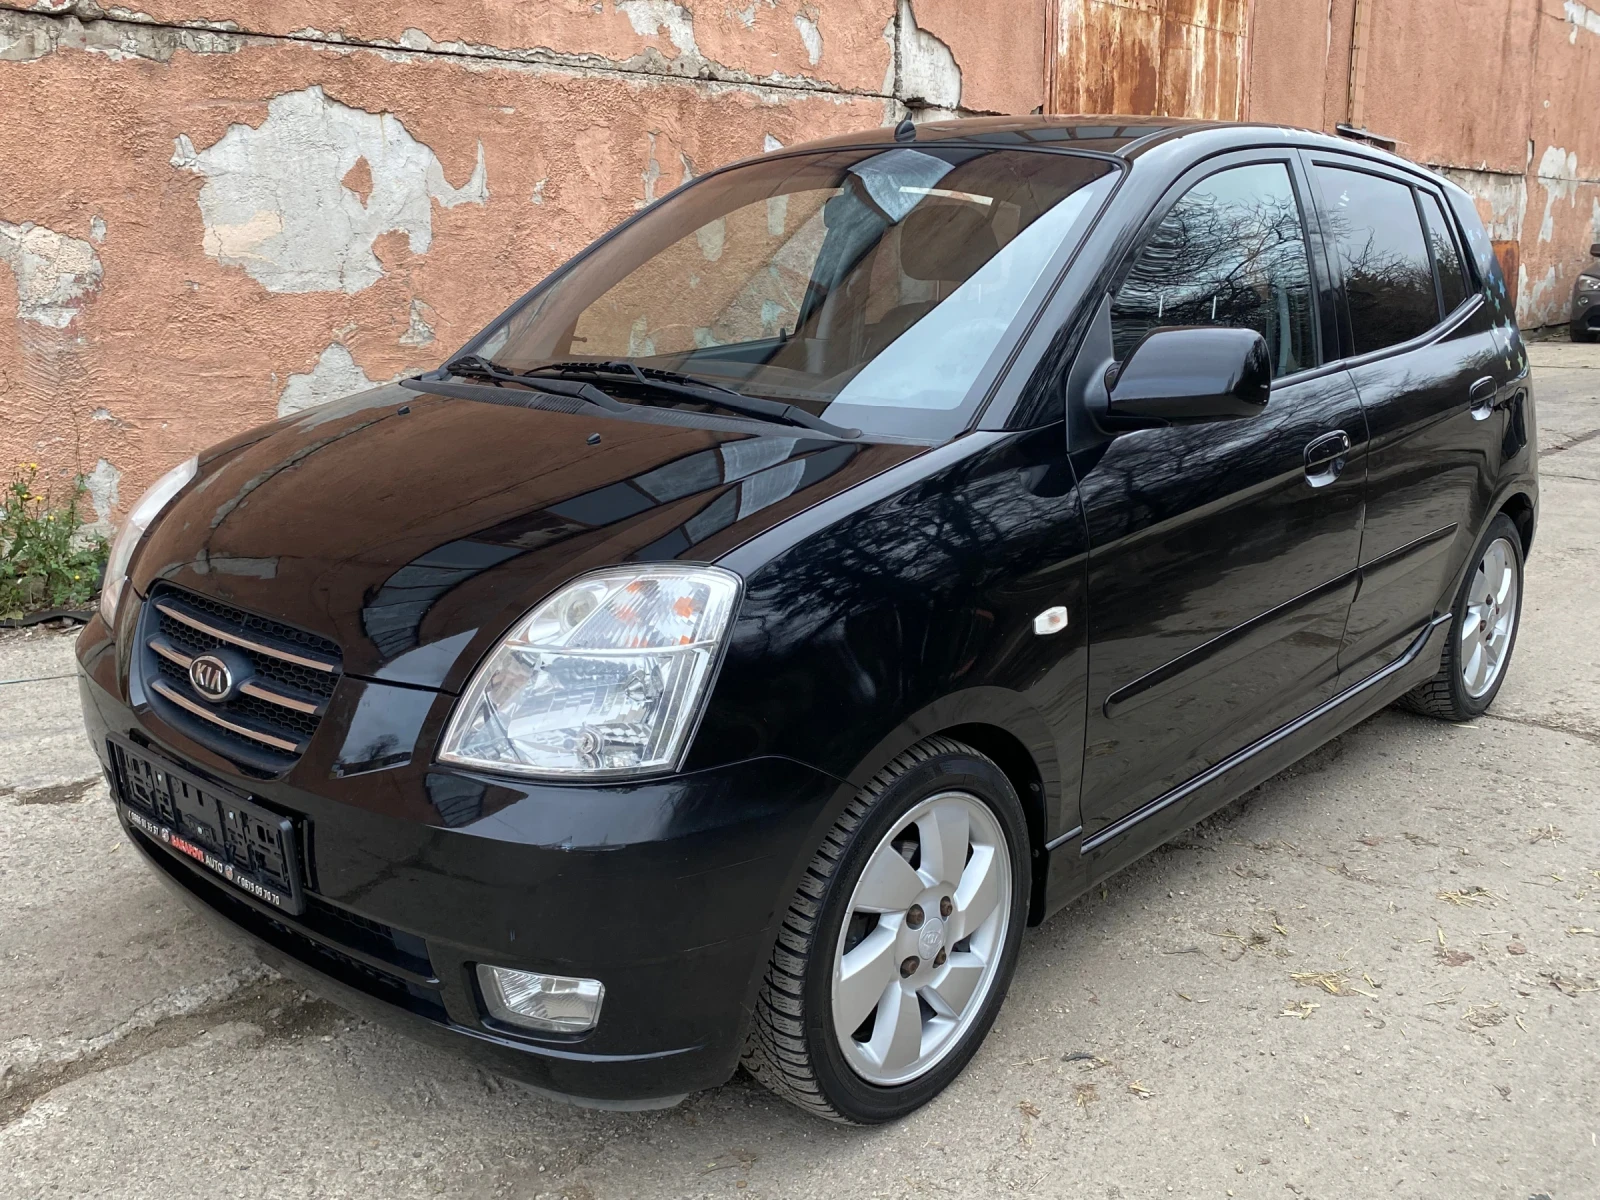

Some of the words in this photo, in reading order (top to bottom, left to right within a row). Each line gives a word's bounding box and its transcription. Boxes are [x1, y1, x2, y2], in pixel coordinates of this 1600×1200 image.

[195, 661, 222, 693] KIA
[205, 854, 223, 874] AUTO
[263, 888, 271, 901] 70
[271, 893, 280, 905] 70
